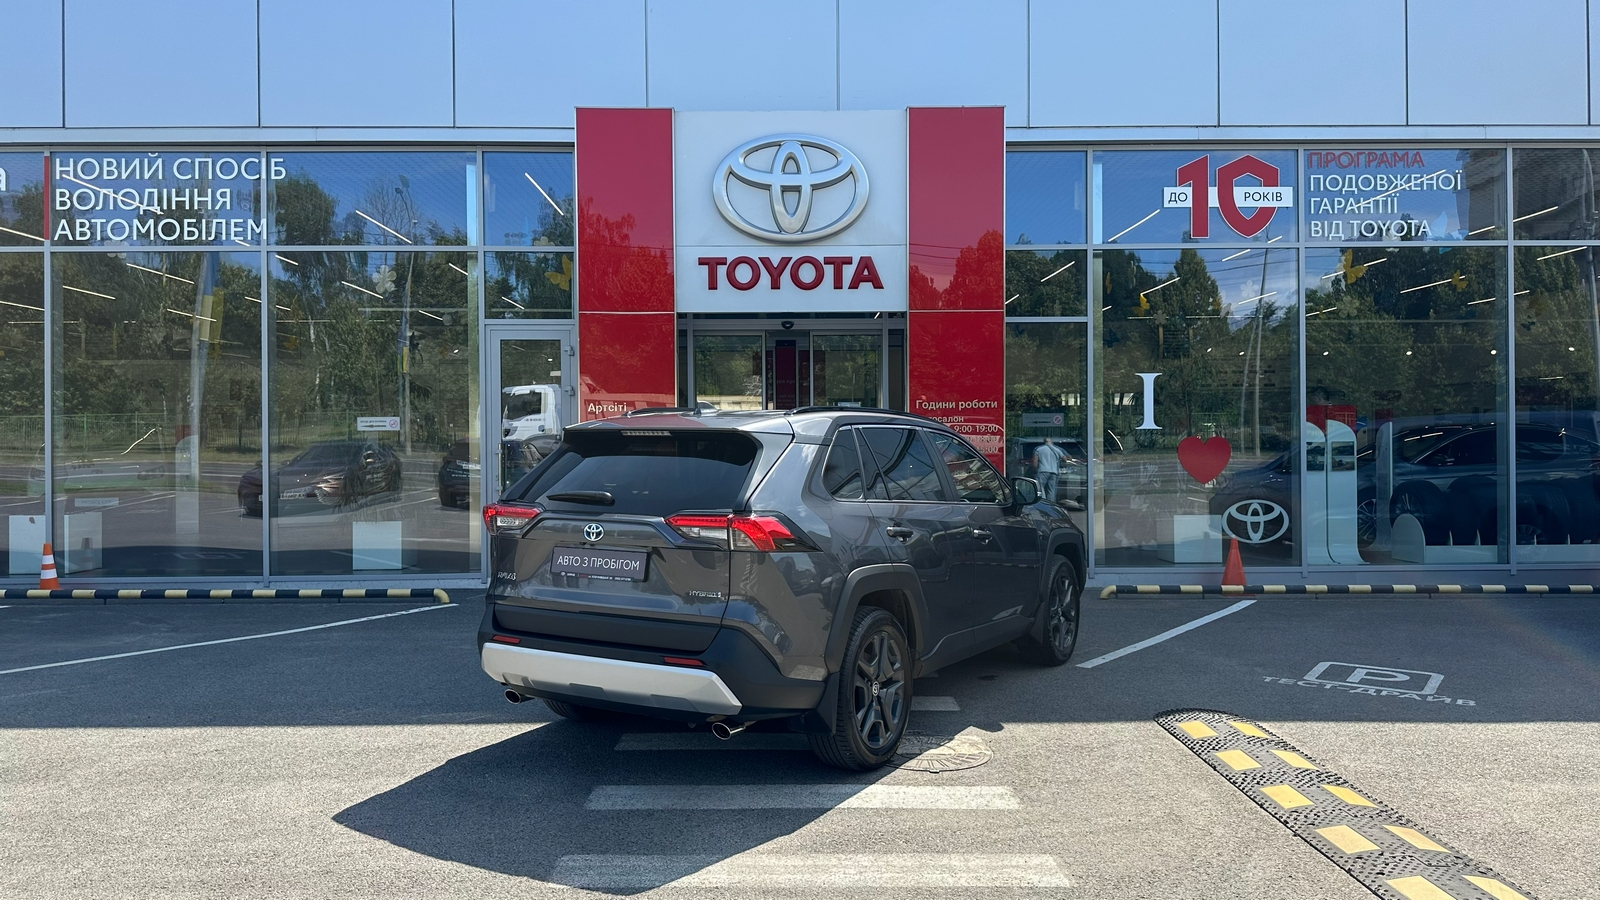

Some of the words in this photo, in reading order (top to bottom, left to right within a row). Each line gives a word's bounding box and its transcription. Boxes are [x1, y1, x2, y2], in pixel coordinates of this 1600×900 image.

[55, 153, 163, 180] НОВИЙ
[173, 157, 287, 180] СПОСІБ
[1308, 151, 1425, 168] ПРОГРАМА
[1310, 169, 1463, 195] ПОДОВЖЕНОЇ
[55, 188, 231, 215] ВОЛОДІННЯ
[1168, 192, 1188, 204] ДО
[1177, 154, 1280, 238] 10
[1244, 191, 1283, 202] РОКІВ
[1310, 193, 1400, 214] ГАРАНТІЇ
[54, 218, 267, 241] АВТОМОБІЛЕМ
[1311, 220, 1345, 241] ВІД
[1350, 220, 1432, 237] TOYOTA
[698, 255, 885, 291] TOYOTA
[587, 402, 627, 415] Артсіті
[916, 400, 955, 410] Години
[958, 399, 998, 411] роботи
[557, 555, 580, 567] АВТО
[590, 557, 640, 571] ПРОБІГОМ
[1261, 676, 1477, 706] ТЕСТ-ДРАЙВ
